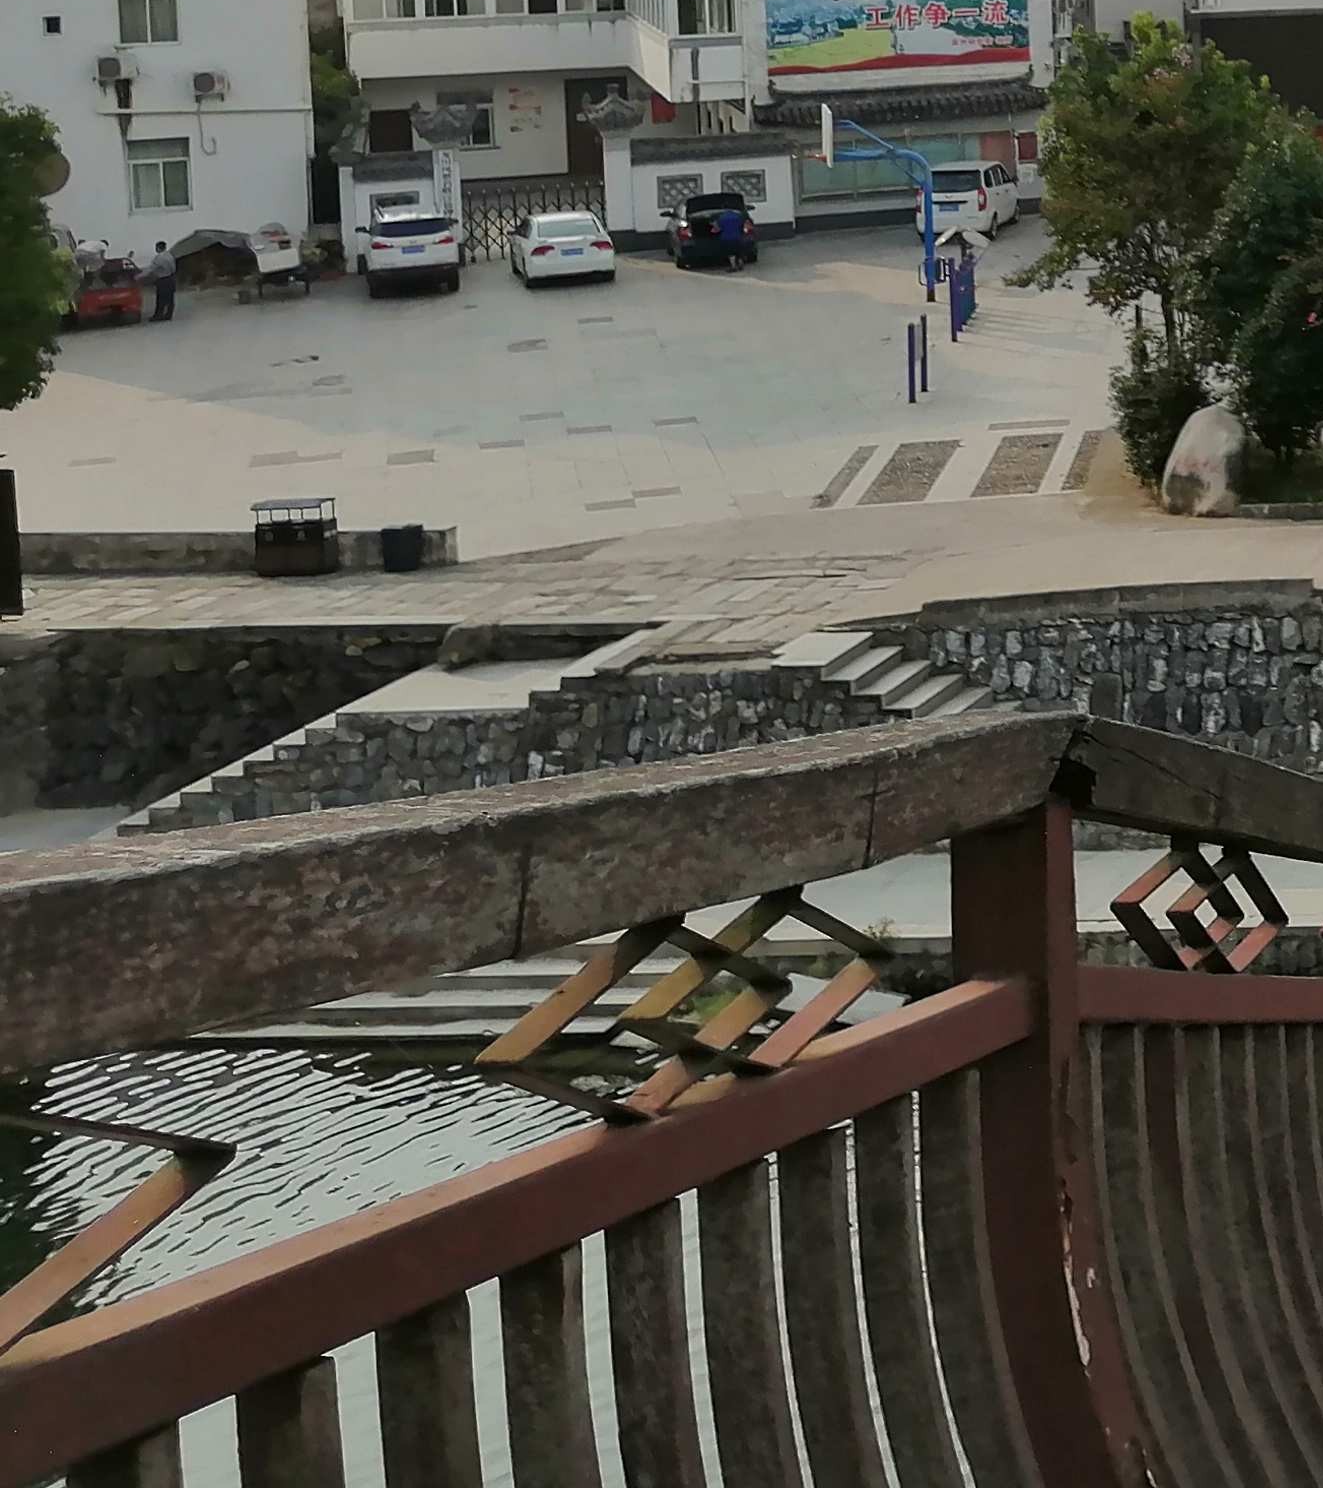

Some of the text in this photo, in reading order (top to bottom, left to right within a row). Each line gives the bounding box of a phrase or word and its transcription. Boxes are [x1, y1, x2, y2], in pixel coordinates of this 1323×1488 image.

[865, 0, 1010, 31] 工作争一流
